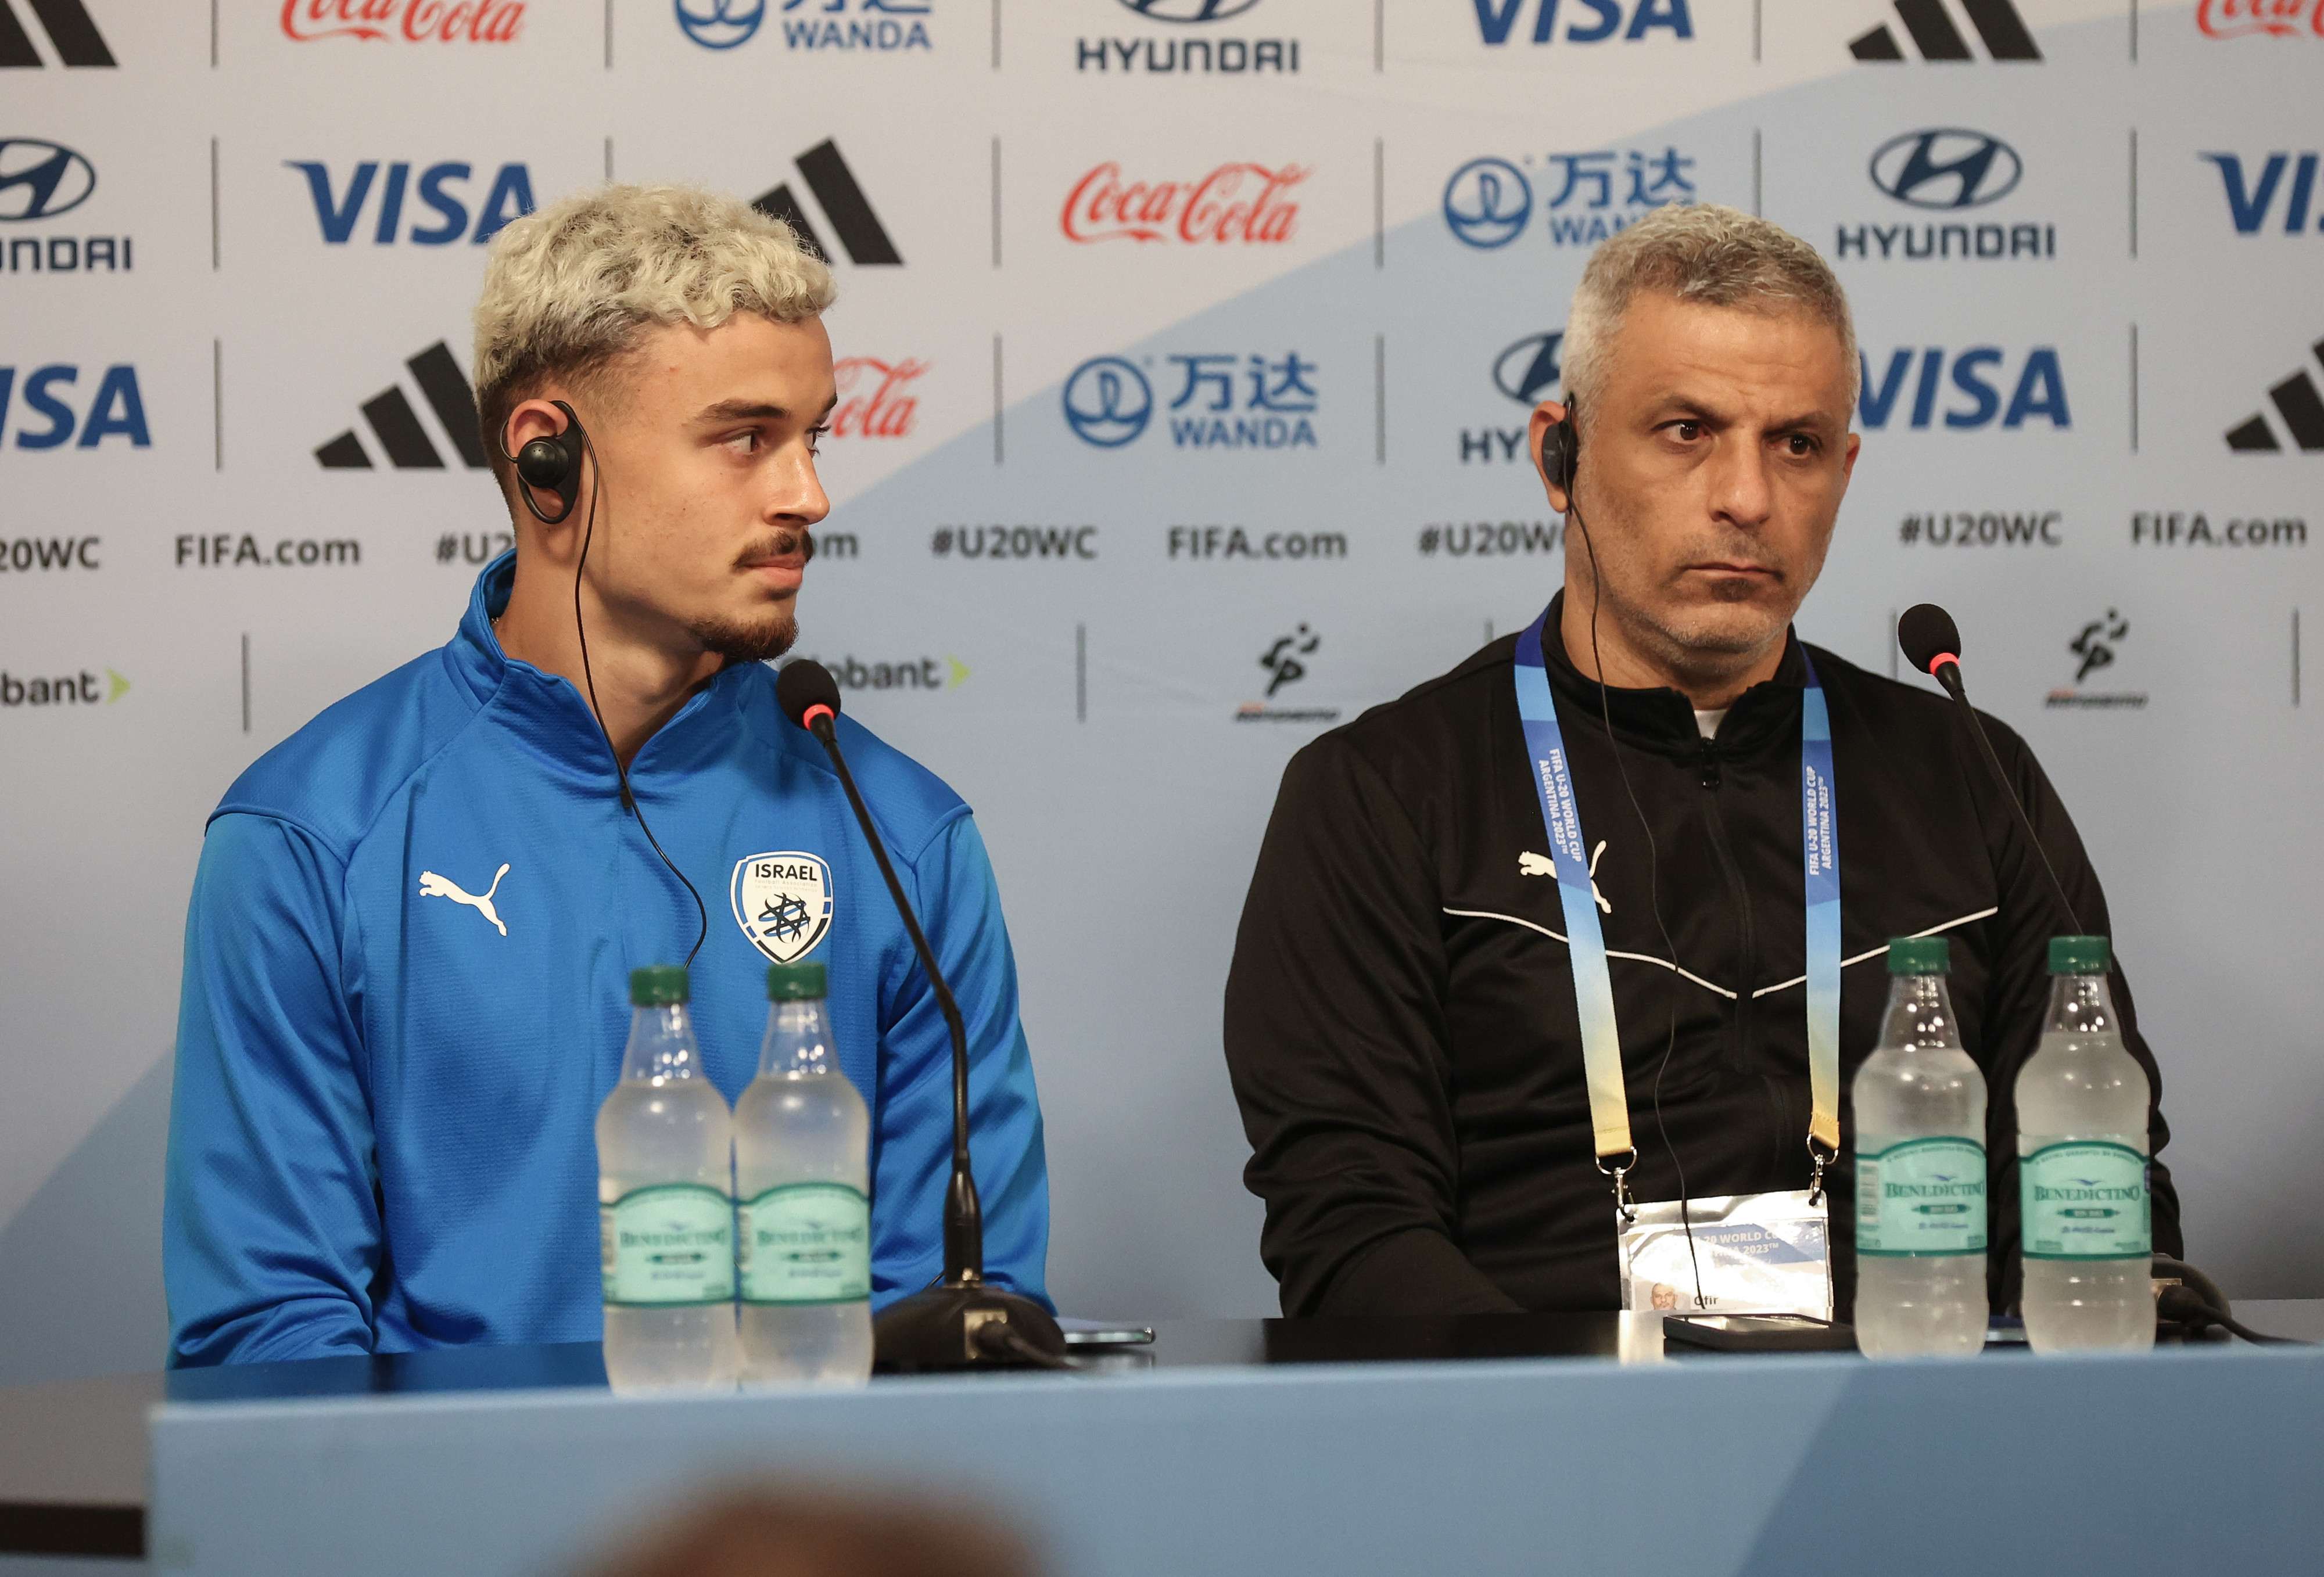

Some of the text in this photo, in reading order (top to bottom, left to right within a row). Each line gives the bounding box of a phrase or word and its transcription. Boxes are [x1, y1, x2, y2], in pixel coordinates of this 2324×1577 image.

[783, 19, 932, 51] WANDA
[1472, 0, 1694, 46] VISA
[1076, 38, 1299, 73] HYUNDAI
[283, 160, 536, 245] VISA
[1059, 161, 1313, 244] Coca-Cola
[1548, 148, 1694, 207] 万达
[2200, 152, 2324, 235] VI
[0, 236, 132, 273] NDAI
[1837, 223, 2056, 260] HYUNDAI
[1168, 351, 1317, 411] 万达
[1858, 346, 2072, 431] VISA
[1170, 415, 1317, 448] WANDA
[175, 533, 361, 567] FIFA.com
[931, 526, 1098, 560] #U20WC
[1168, 526, 1347, 559] FIFA.com
[1418, 522, 1565, 557] #U20W
[1900, 512, 2063, 547] #U20WC
[2131, 513, 2307, 547] FIFA.com
[1538, 760, 1561, 819] ARGENTINA
[1550, 748, 1583, 862] FIFA U-20 WORLD CUP
[1806, 765, 1820, 875] FIFA U-20 WORLD CUP
[1820, 810, 1832, 870] ARGENTINA
[755, 864, 817, 881] ISRAEL
[1885, 1183, 1985, 1198] BENEDICTIN
[2035, 1186, 2139, 1201] BENEDICTINO
[1720, 1231, 1762, 1244] WORLD
[1694, 1295, 1719, 1306] Ofir
